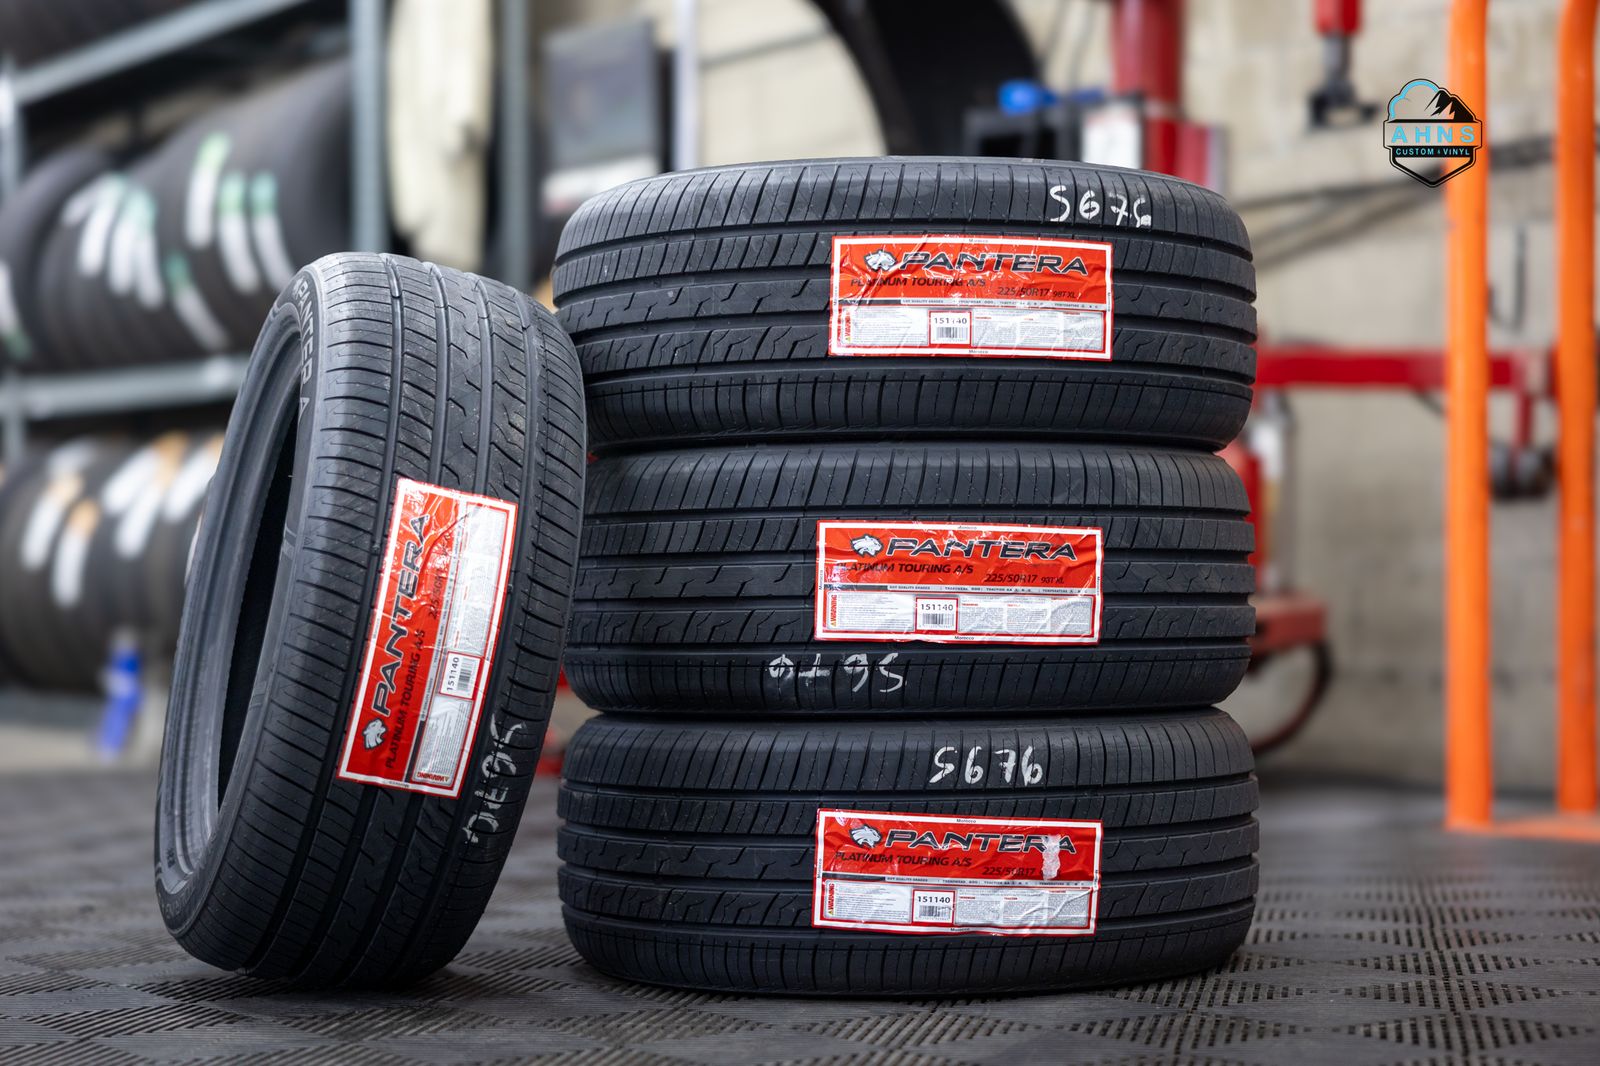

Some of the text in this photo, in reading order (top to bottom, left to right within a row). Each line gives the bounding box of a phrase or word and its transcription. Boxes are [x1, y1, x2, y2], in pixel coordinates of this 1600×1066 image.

[899, 251, 1089, 276] PANTERA
[850, 277, 986, 287] PLATINUM TOURING A/S
[997, 286, 1050, 297] 225/50R17
[885, 537, 1077, 561] PANTERA
[836, 562, 974, 574] PLATINUM TOURING A/S
[984, 573, 1038, 583] 225/50R17
[371, 514, 430, 717] PANTERA
[921, 603, 953, 611] 151140
[446, 656, 460, 691] 151140
[385, 628, 426, 769] PLATINUM TOURING A/S
[929, 746, 1043, 787] 5676
[884, 828, 1077, 854] PANTERA
[834, 851, 972, 867] PLATINUM TOURING A/S
[918, 895, 951, 903] 151140
